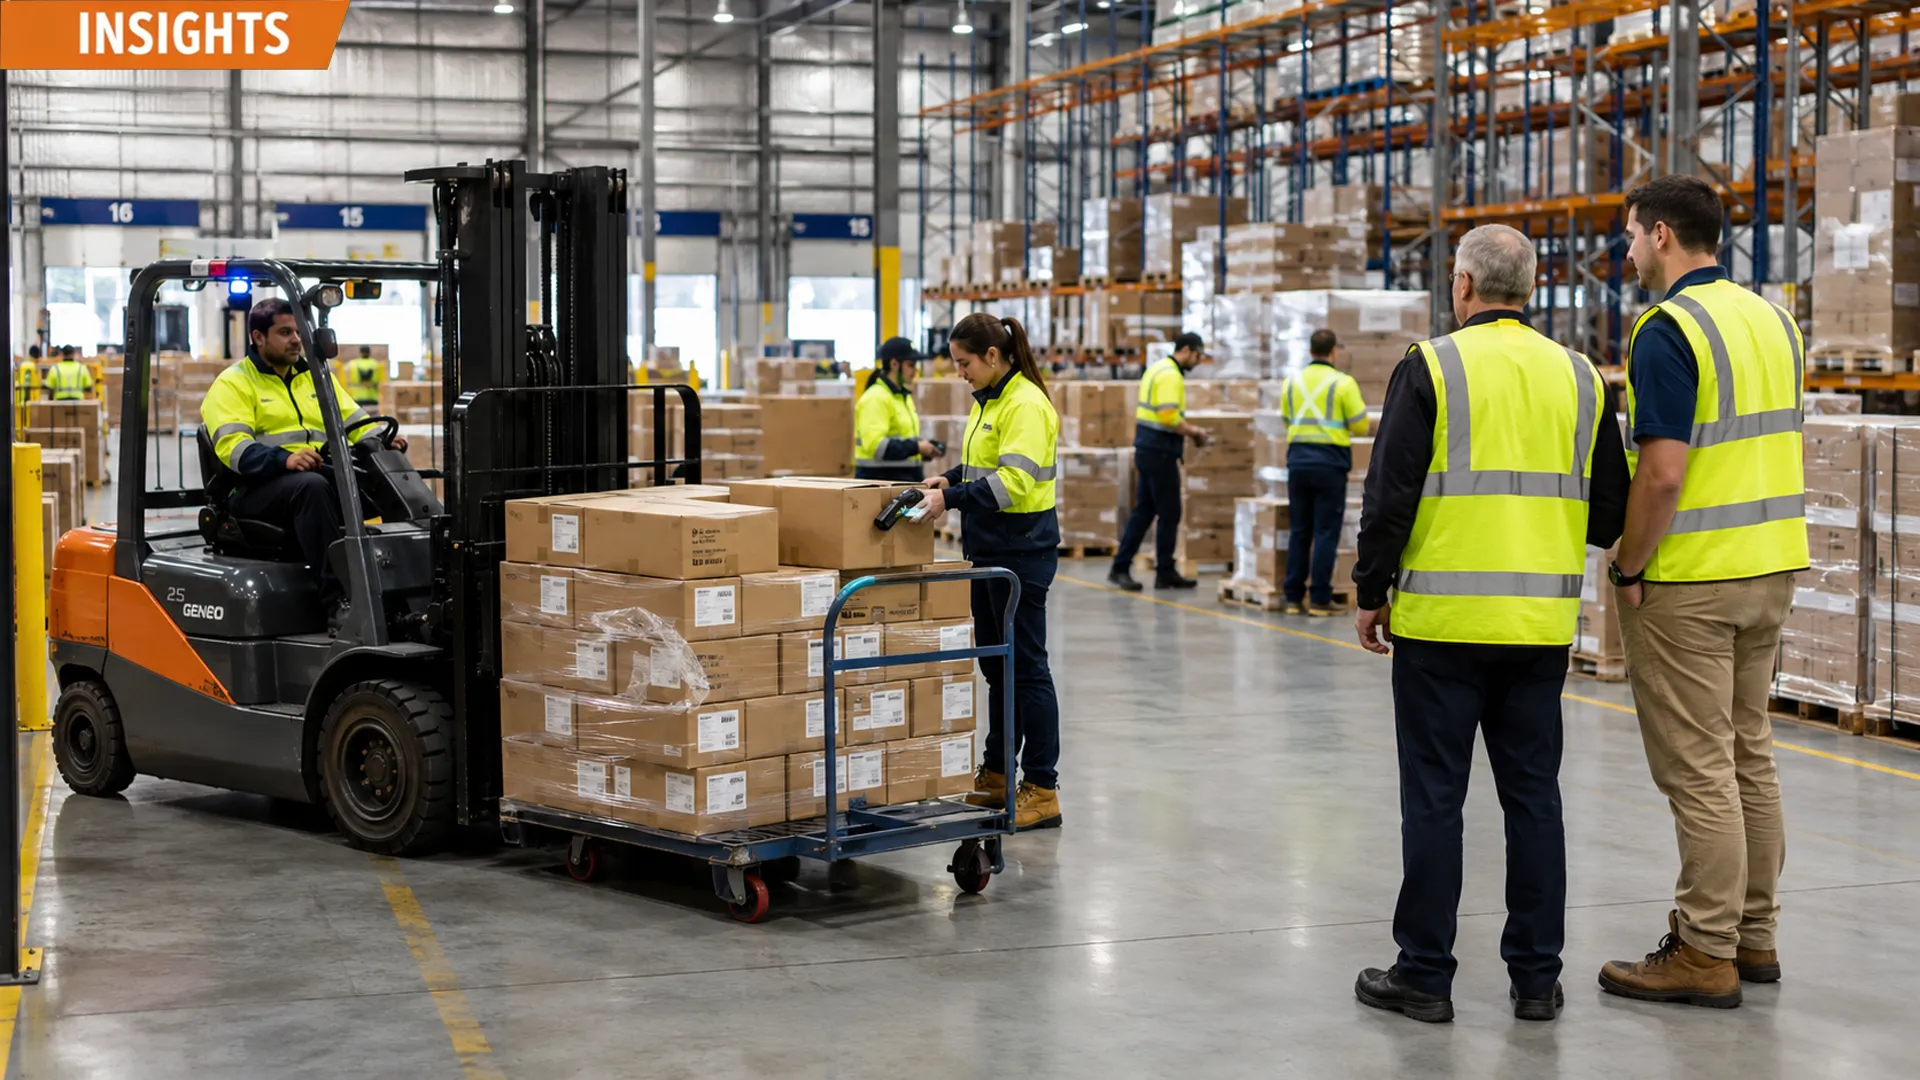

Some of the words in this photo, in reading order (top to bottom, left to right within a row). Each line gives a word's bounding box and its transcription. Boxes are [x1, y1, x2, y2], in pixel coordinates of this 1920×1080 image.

[108, 202, 134, 223] 16
[339, 206, 364, 228] 15
[167, 586, 186, 602] 25
[183, 603, 224, 620] GENEO
